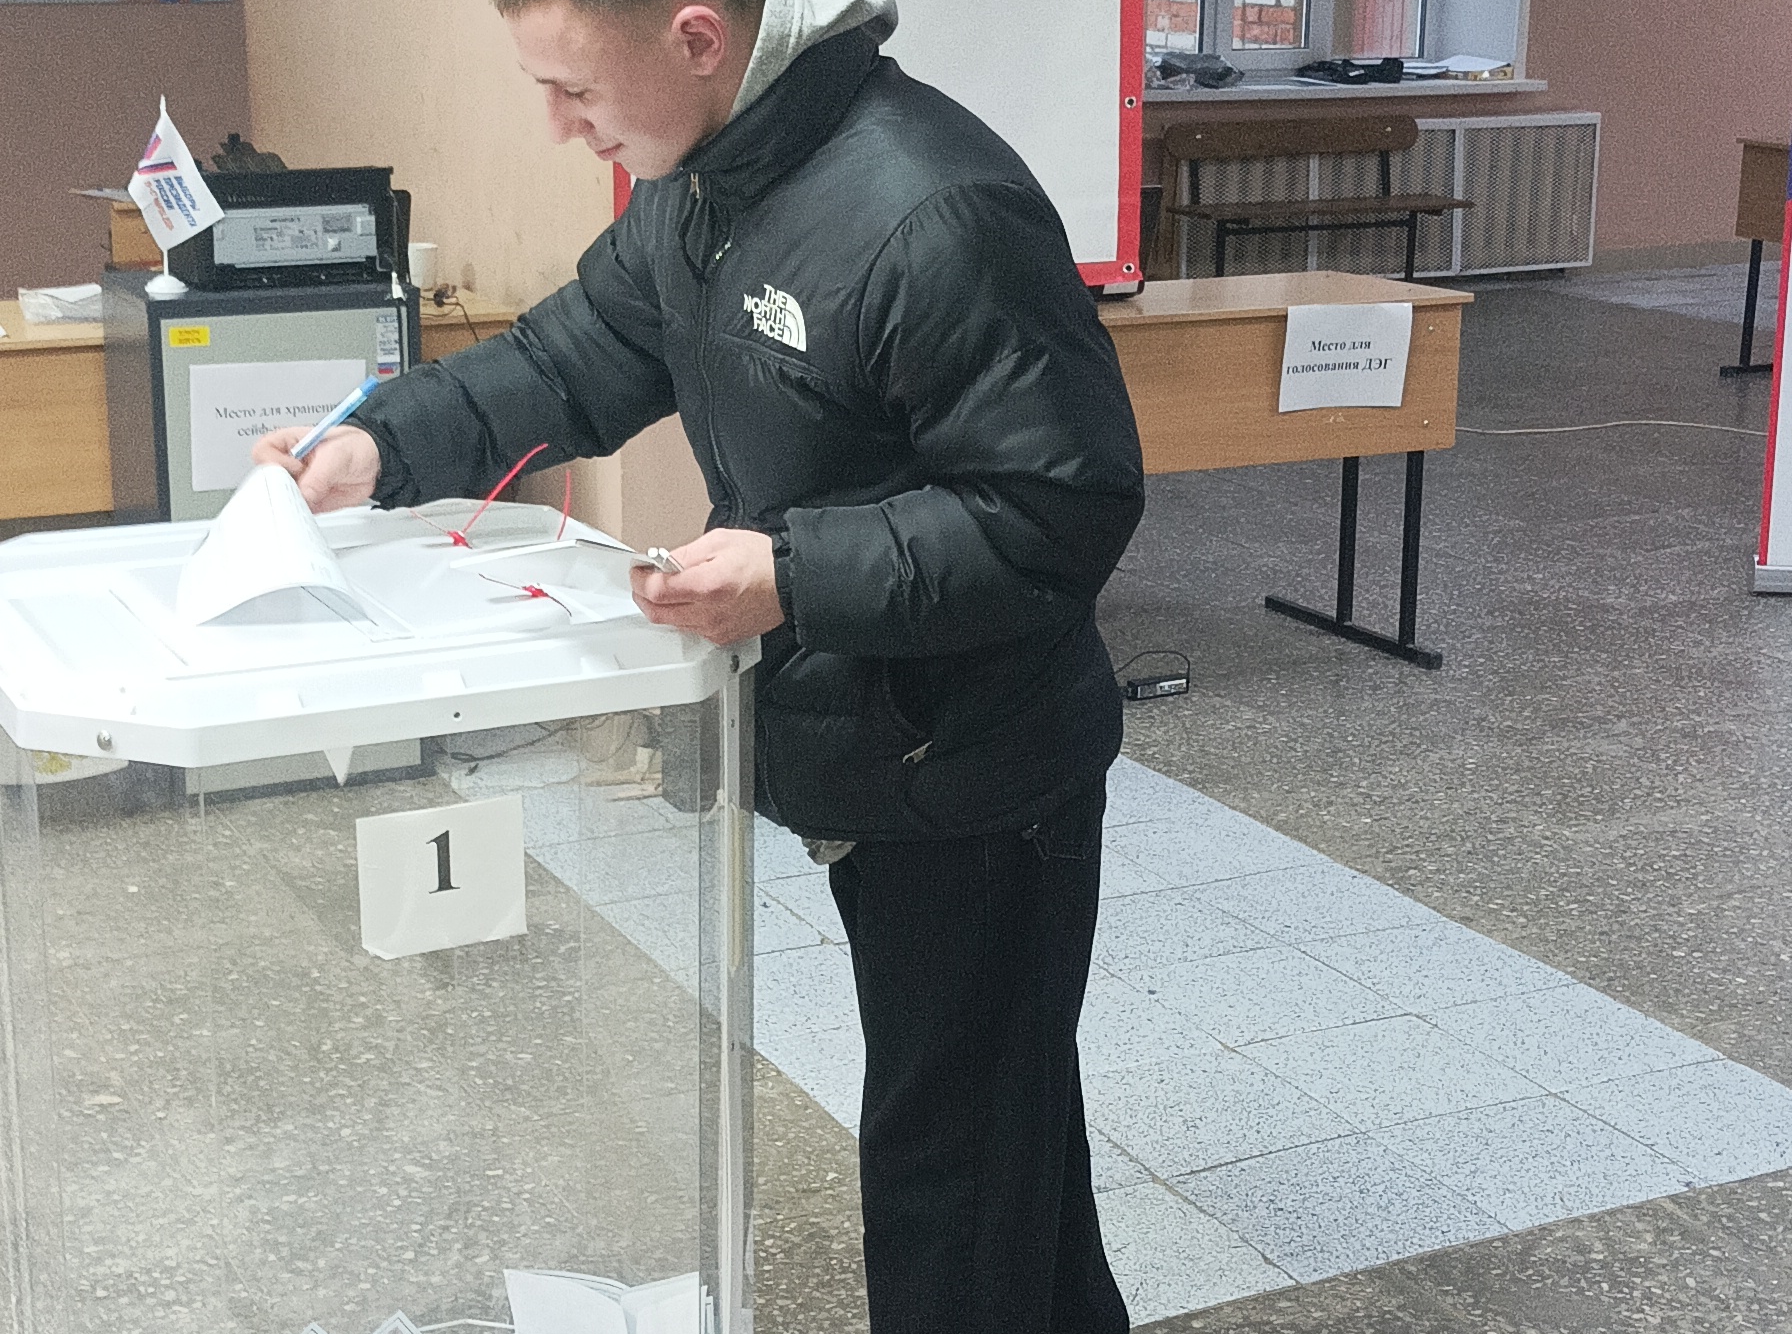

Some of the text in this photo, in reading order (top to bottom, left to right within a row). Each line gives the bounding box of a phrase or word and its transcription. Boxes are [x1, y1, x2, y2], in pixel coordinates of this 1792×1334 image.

[763, 283, 787, 309] THE
[743, 293, 785, 326] NORTH
[753, 312, 784, 341] FACE
[1308, 340, 1371, 352] Место для
[1286, 357, 1392, 375] голосования ДЭГ
[214, 406, 256, 419] Место
[259, 406, 282, 418] для
[425, 829, 461, 895] 1
